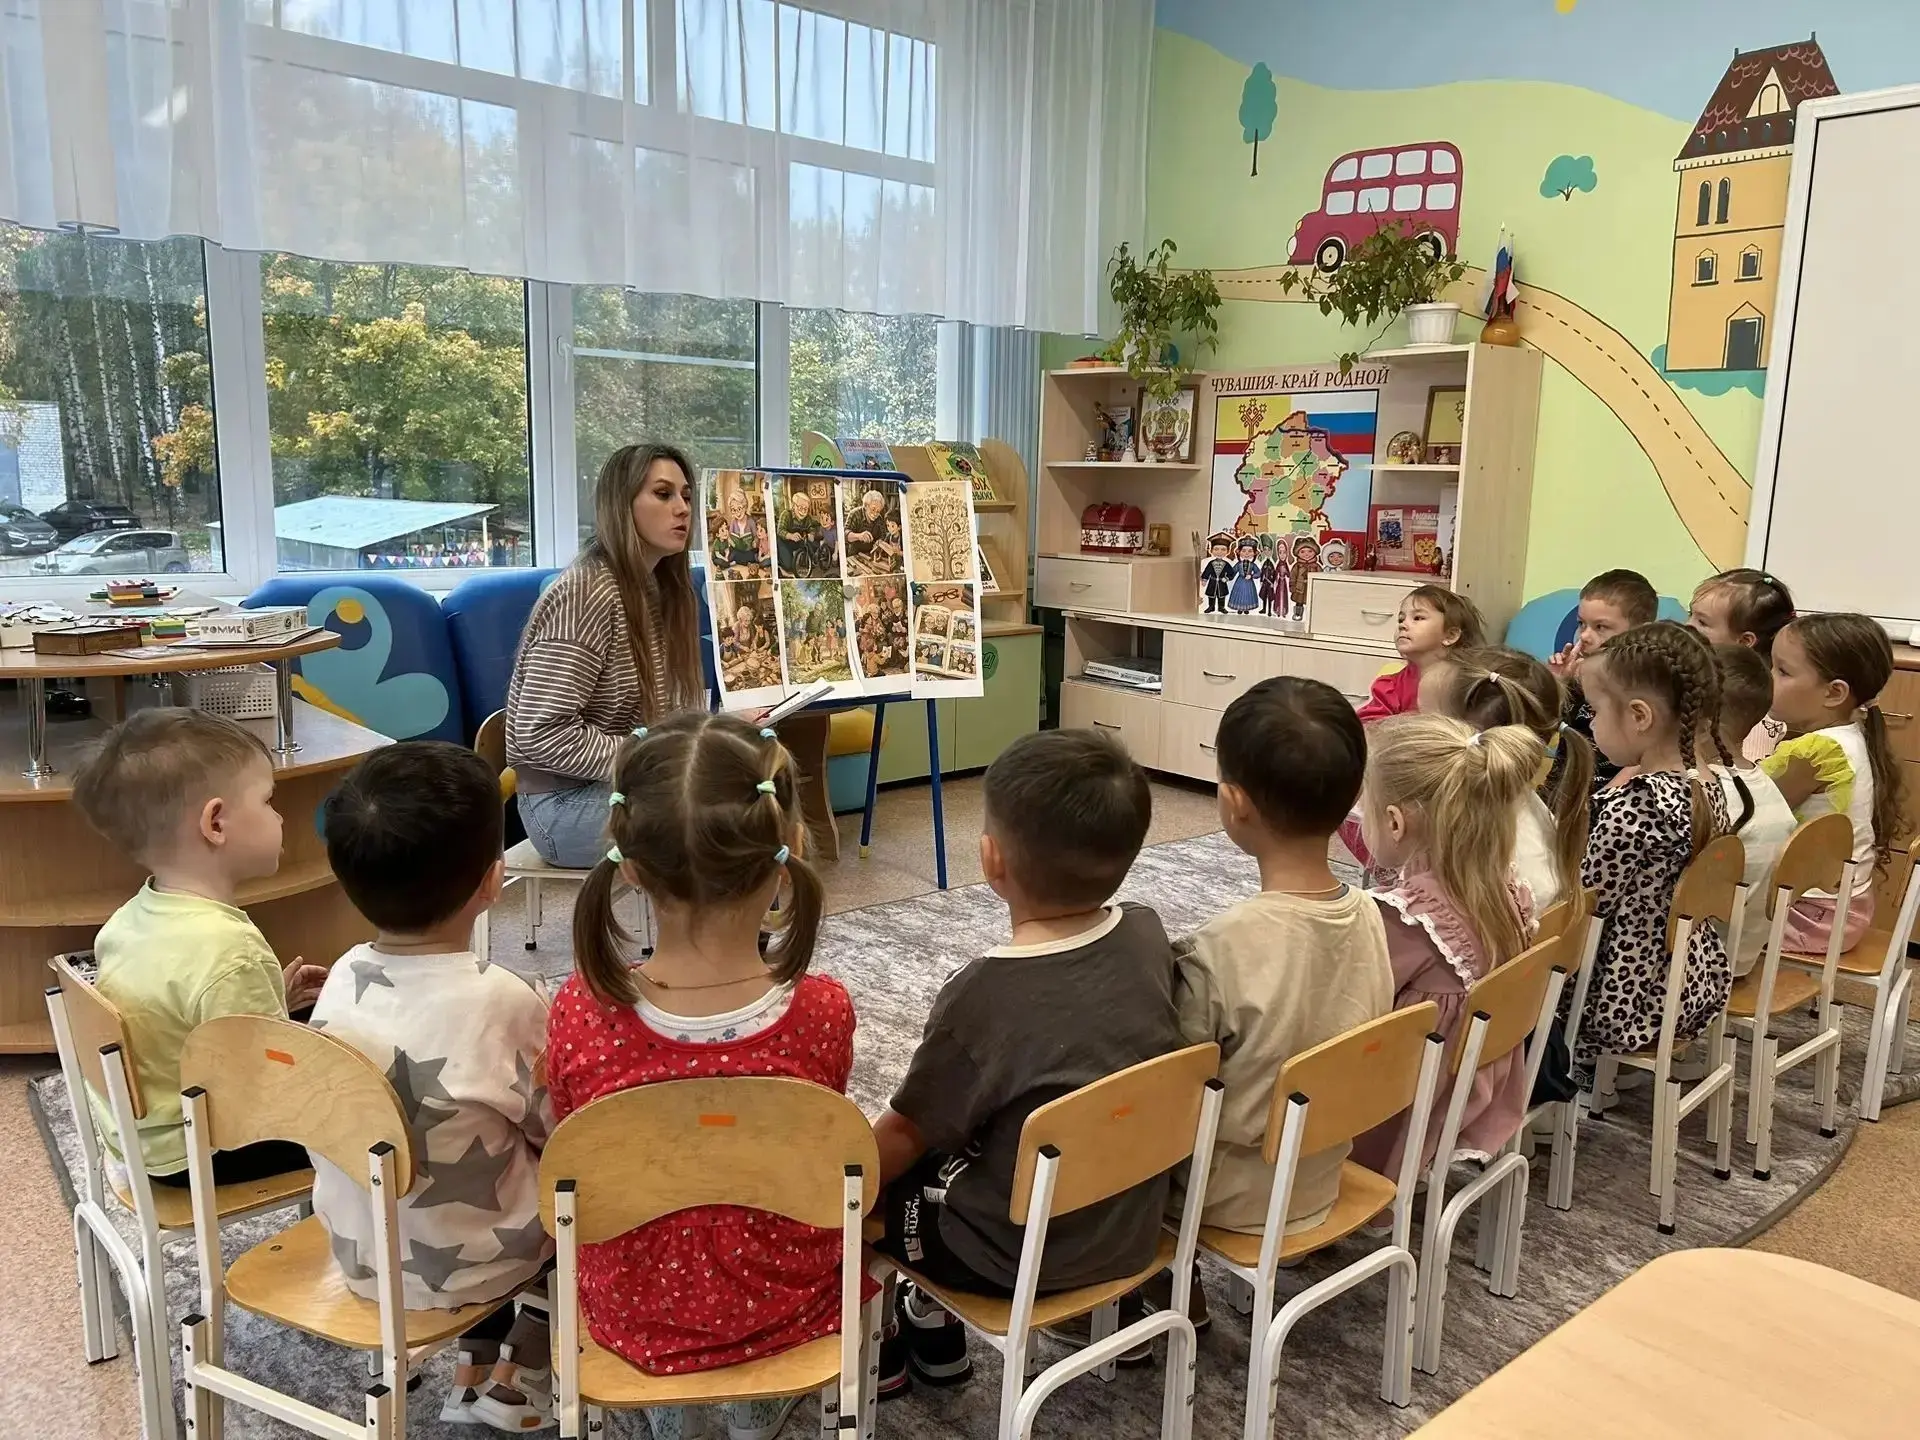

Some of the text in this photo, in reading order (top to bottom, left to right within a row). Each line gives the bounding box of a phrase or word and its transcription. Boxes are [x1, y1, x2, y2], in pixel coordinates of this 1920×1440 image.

[1281, 369, 1320, 389] КРАЙ
[1324, 366, 1390, 388] РОДНОЙ
[201, 625, 243, 634] ТОМИК
